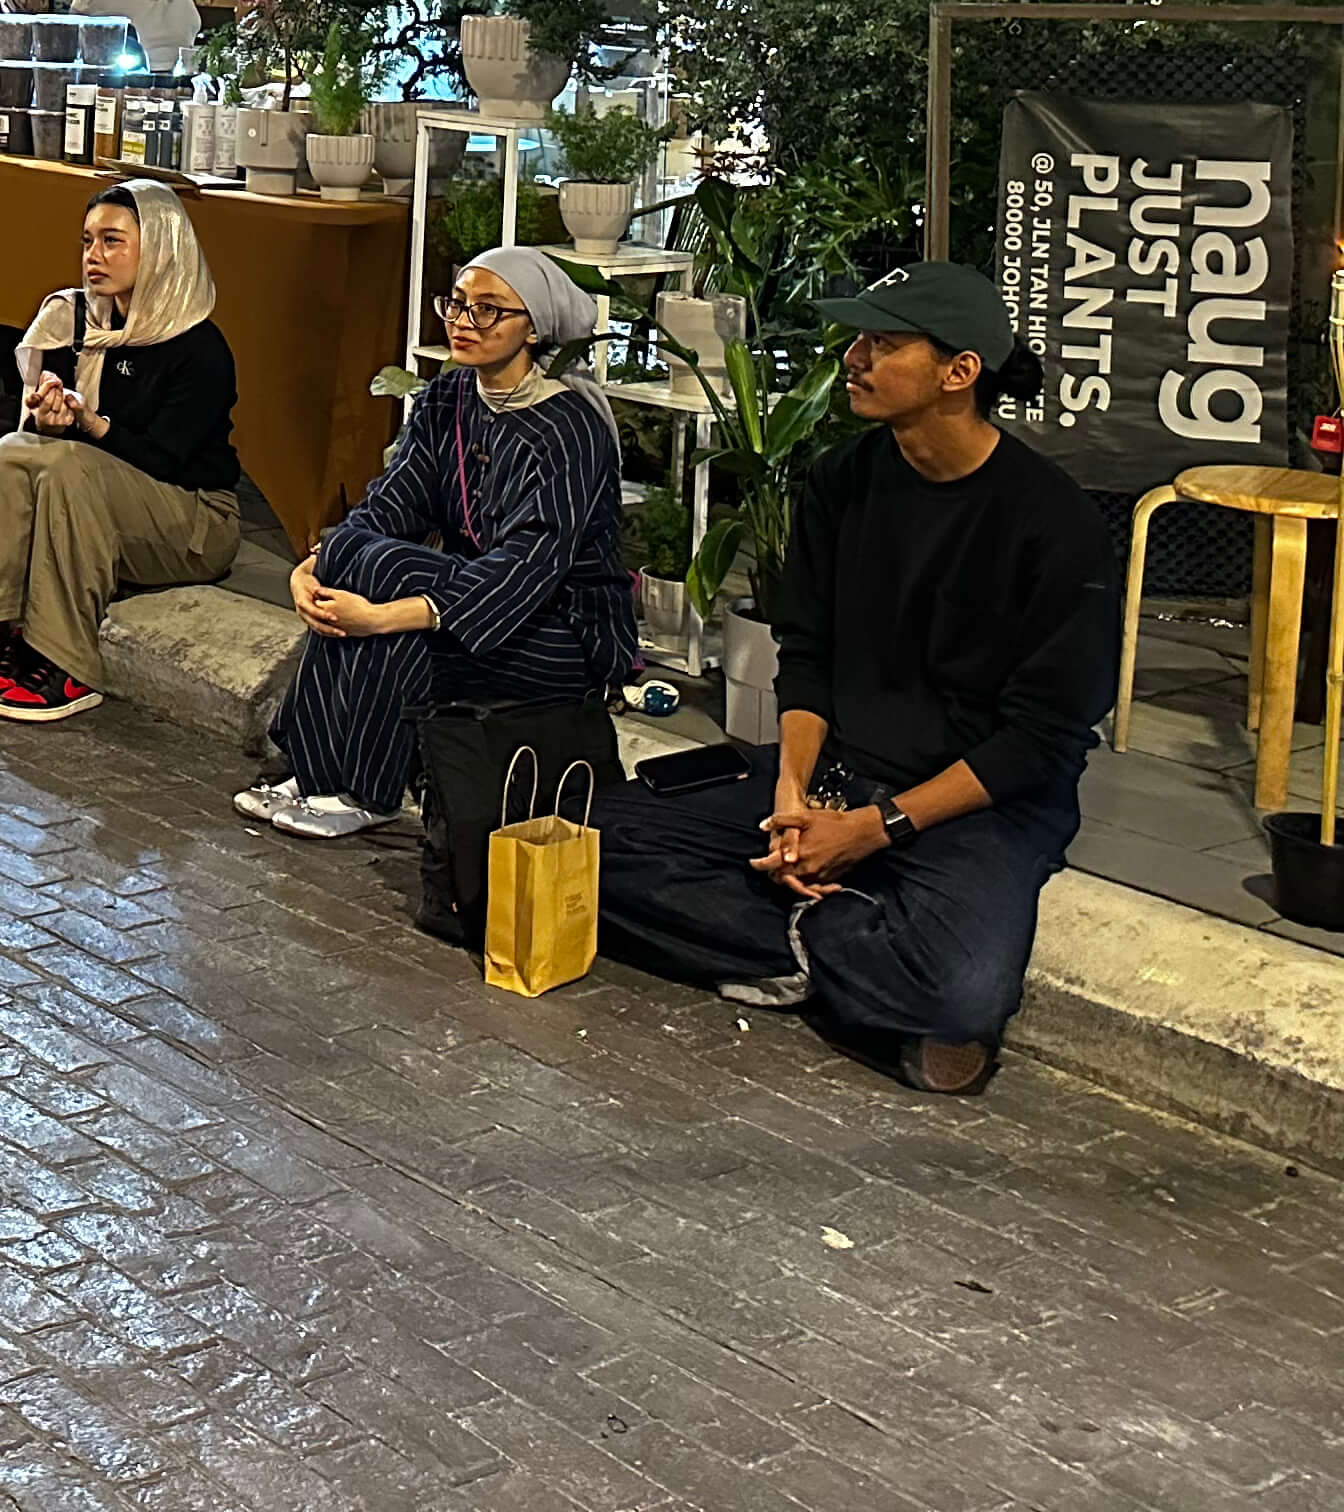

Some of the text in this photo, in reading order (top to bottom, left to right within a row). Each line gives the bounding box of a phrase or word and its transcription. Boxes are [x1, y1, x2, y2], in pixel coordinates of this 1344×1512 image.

[1004, 180, 1025, 251] 80000
[1028, 152, 1055, 358] @ 50, JLN TAN HIO
[1059, 153, 1120, 428] PLANTS.
[1126, 157, 1184, 318] JUST
[1158, 159, 1272, 444] naug
